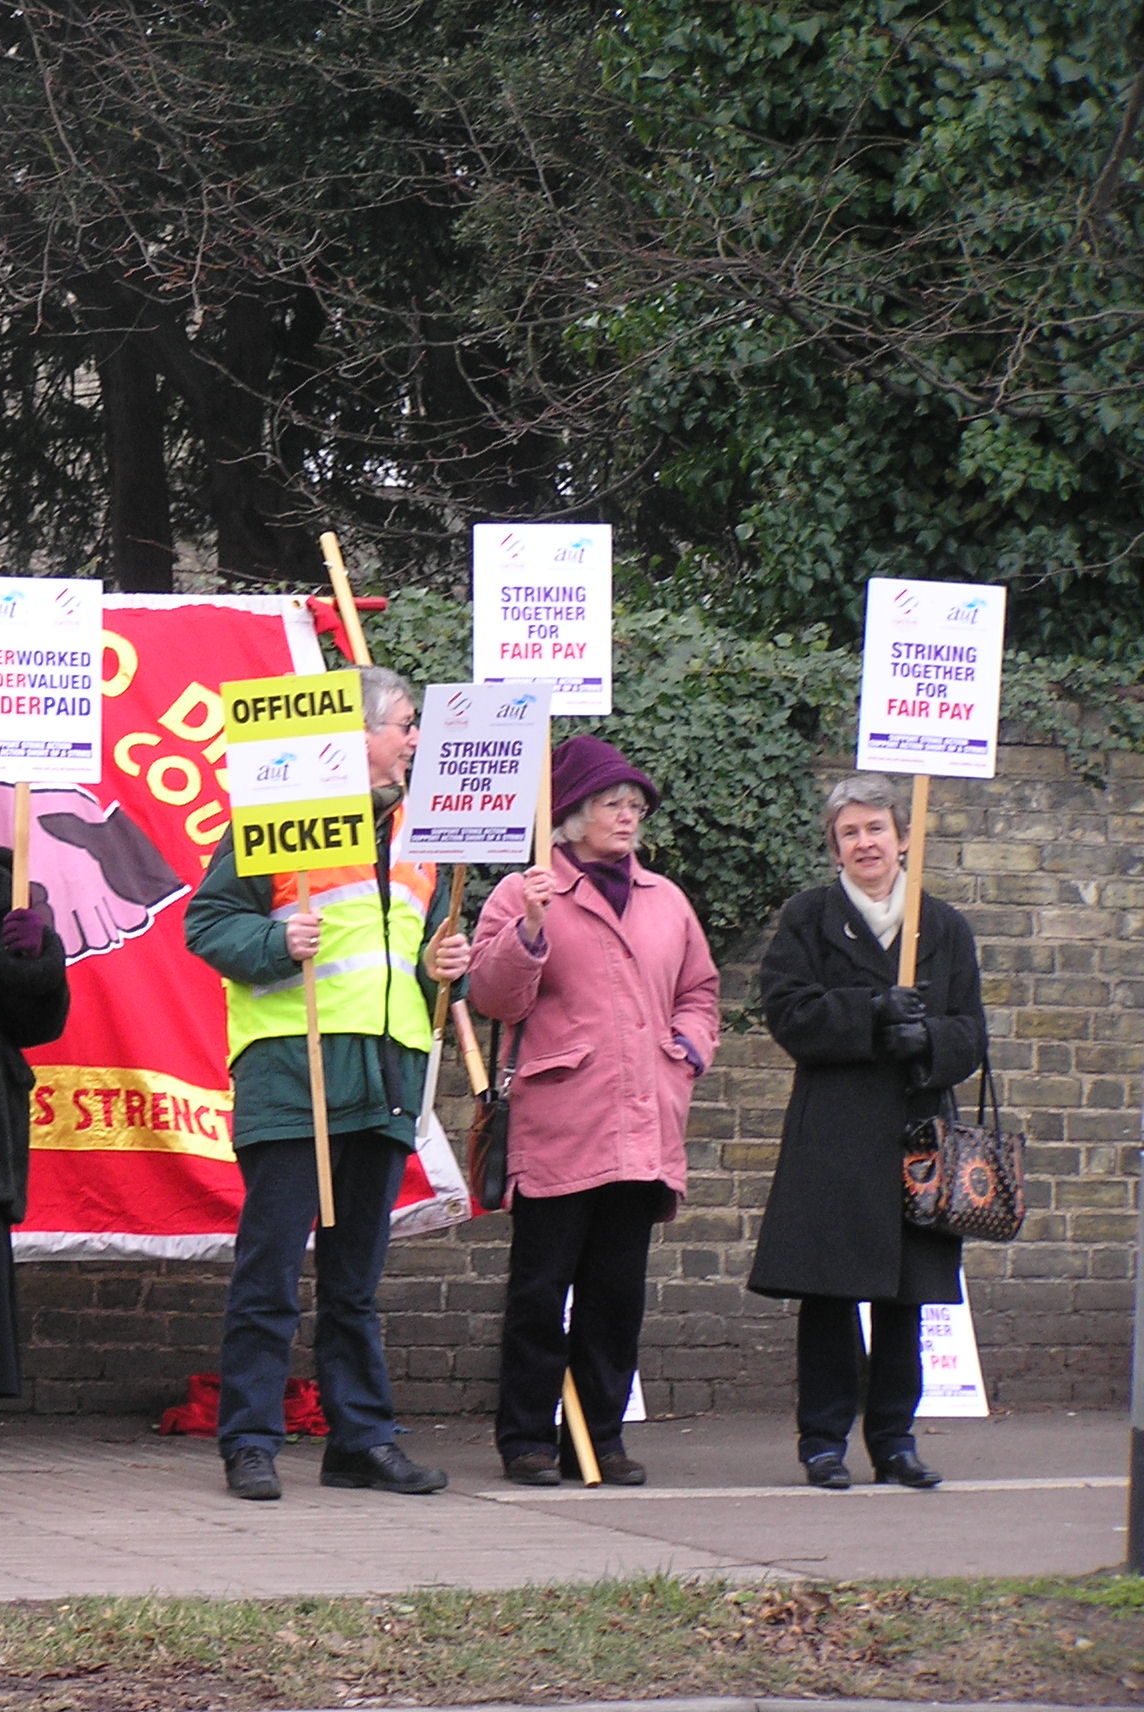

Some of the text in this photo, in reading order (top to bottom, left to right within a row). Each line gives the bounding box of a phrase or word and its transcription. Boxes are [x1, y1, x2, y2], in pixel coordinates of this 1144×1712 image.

[501, 586, 586, 603] STRIKING
[501, 606, 586, 621] TOGETHER
[527, 624, 559, 639] FOR
[500, 642, 587, 660] FAIR PAY
[891, 641, 977, 664] STRIKING
[890, 662, 975, 682] TOGETHER
[915, 682, 948, 699] FOR
[232, 689, 353, 724] OFFICIAL
[887, 698, 975, 721] FAIR PAY
[440, 740, 523, 758] STRIKING
[439, 760, 519, 775] TOGETHER
[460, 777, 492, 792] FOR
[431, 794, 517, 812] FAIR PAY
[243, 814, 363, 857] PICKET
[930, 1354, 958, 1369] PAY
